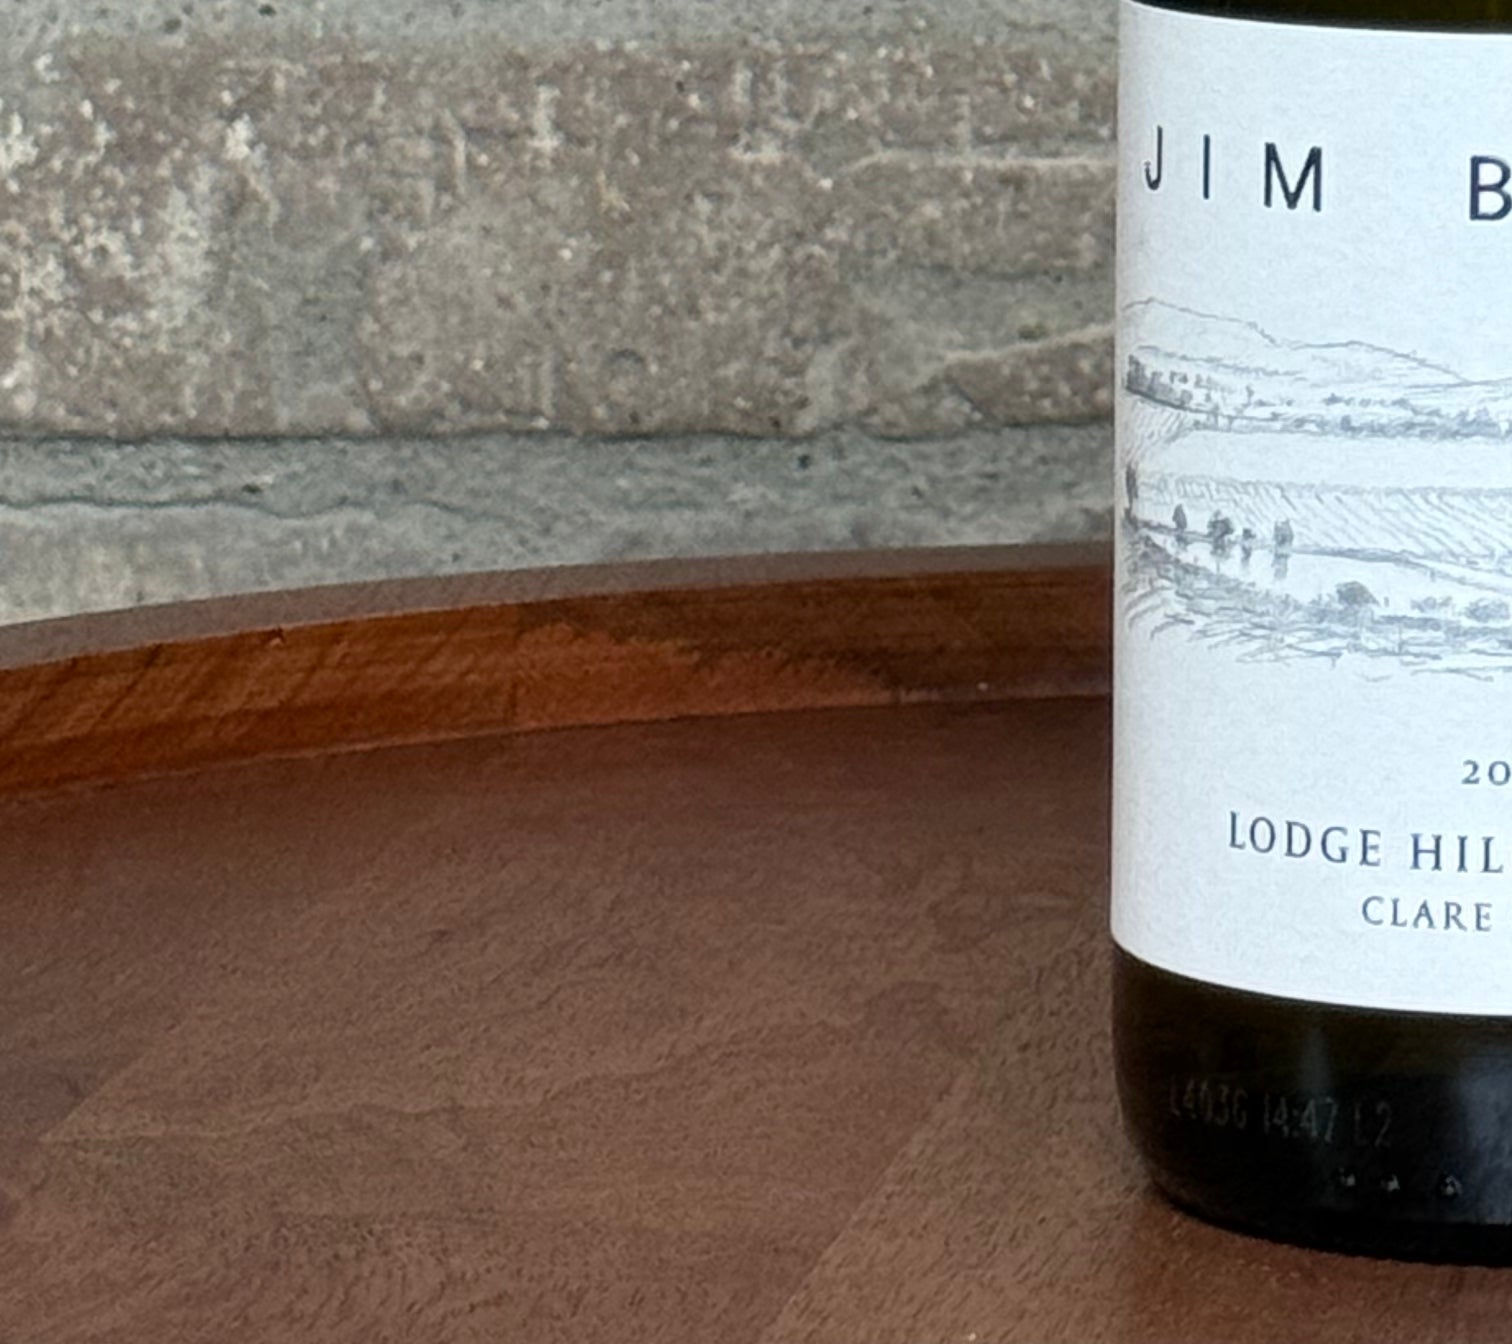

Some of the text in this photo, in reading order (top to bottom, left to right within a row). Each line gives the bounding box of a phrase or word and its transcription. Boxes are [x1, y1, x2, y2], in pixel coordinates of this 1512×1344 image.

[1143, 124, 1323, 213] JIM
[1228, 810, 1382, 868] LODGE
[1361, 895, 1493, 933] CLARE
